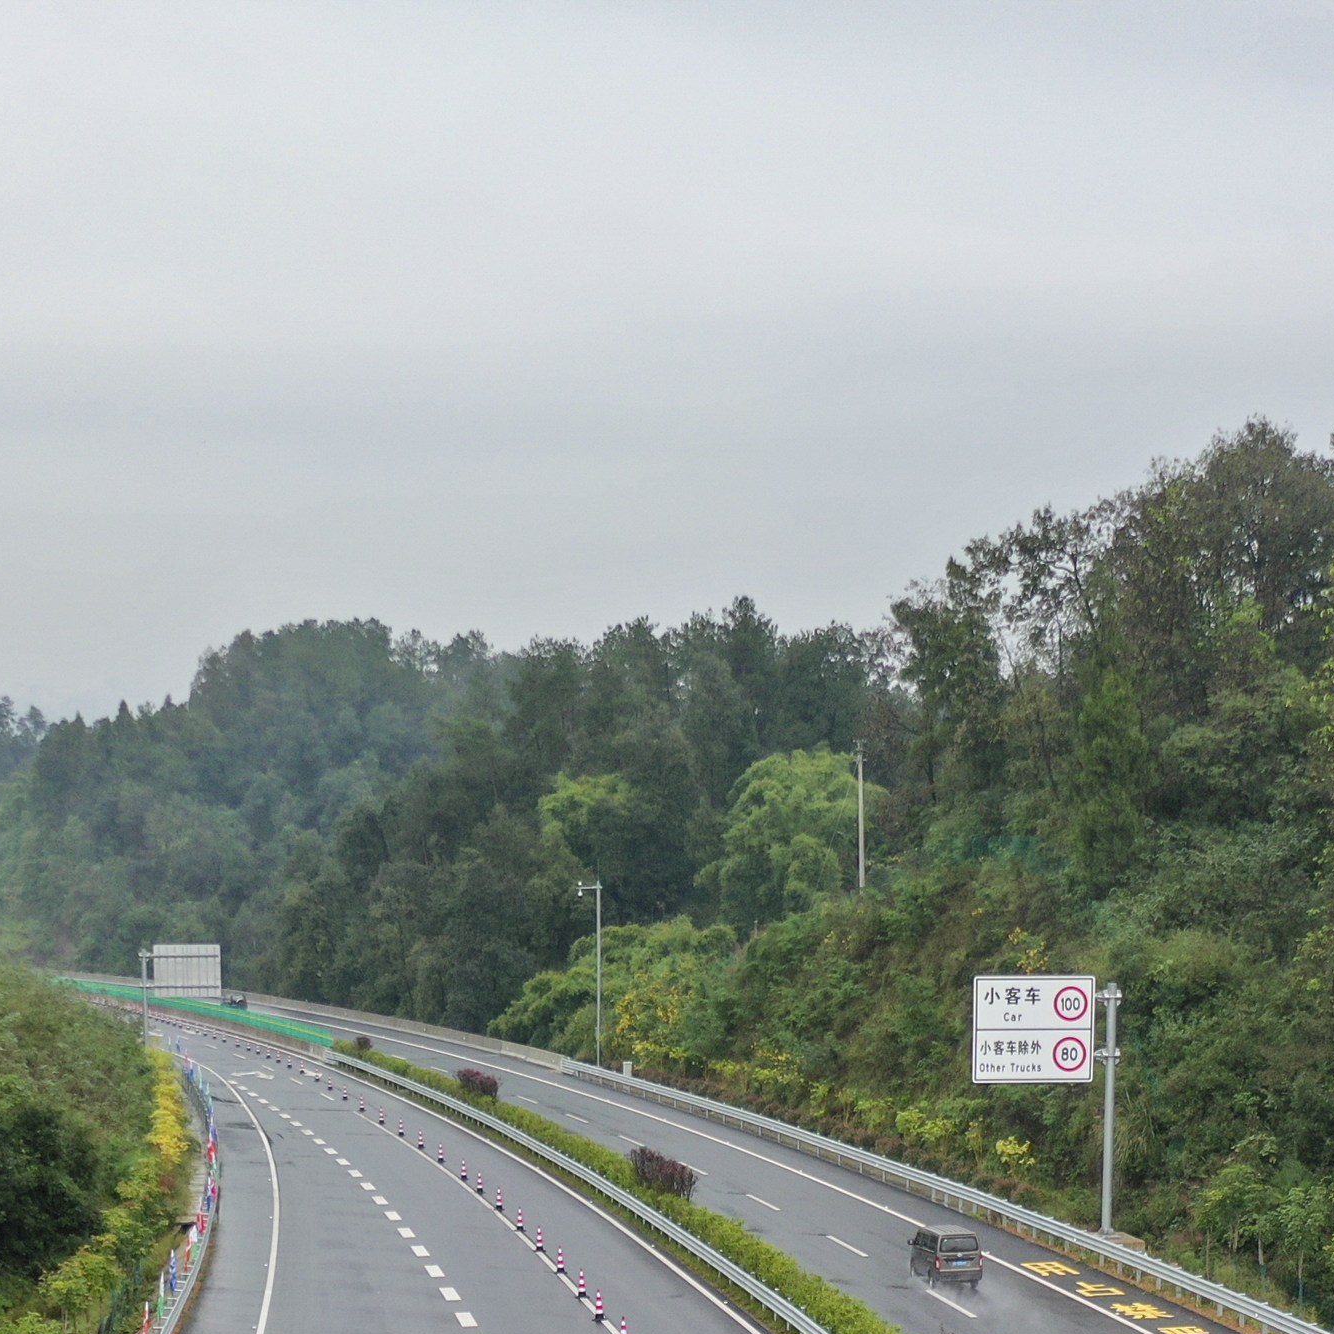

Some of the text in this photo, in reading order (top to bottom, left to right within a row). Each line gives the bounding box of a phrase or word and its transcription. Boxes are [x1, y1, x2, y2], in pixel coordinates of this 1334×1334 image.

[984, 987, 1041, 1005] 小客车
[1061, 997, 1080, 1011] 100
[1003, 1012, 1023, 1022] Car
[980, 1040, 1042, 1055] 小客车除外
[1061, 1047, 1078, 1061] 80
[979, 1062, 1042, 1073] Other Trucks
